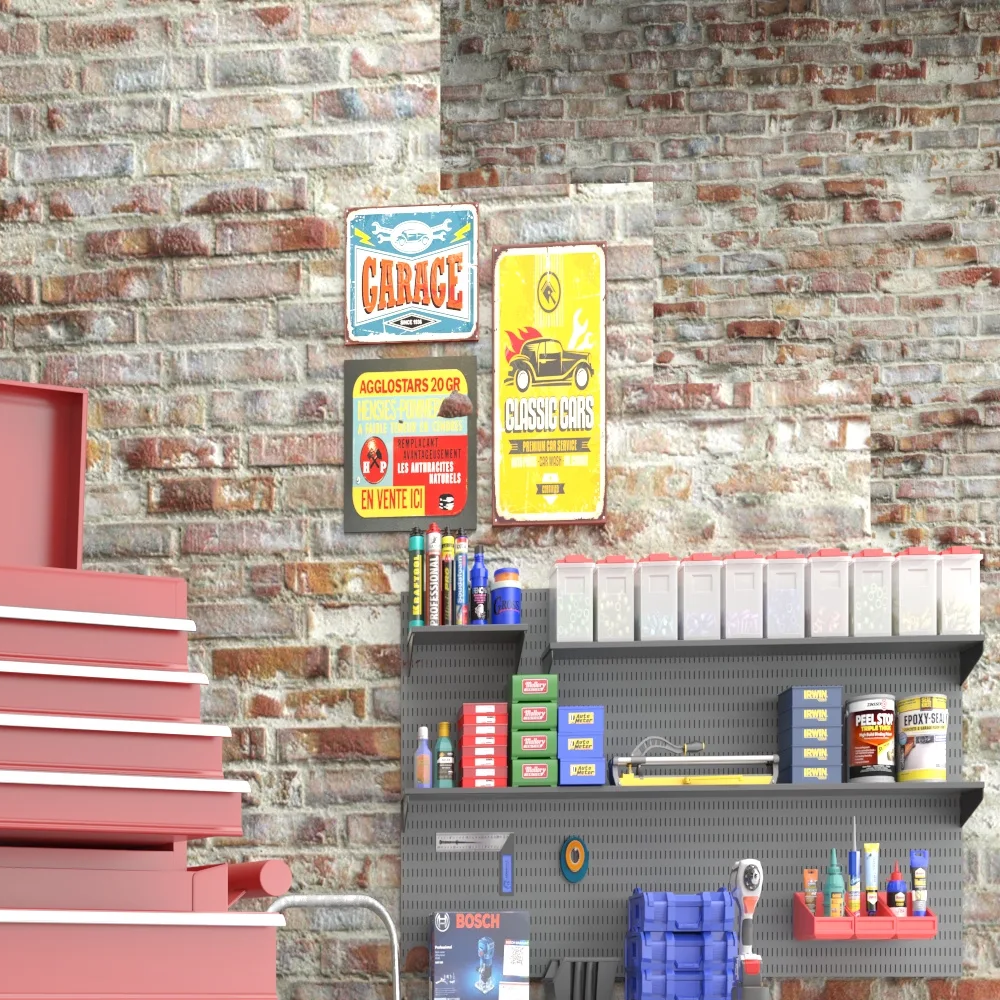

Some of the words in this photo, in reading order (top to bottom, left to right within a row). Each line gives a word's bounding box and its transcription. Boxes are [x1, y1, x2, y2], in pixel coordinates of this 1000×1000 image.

[361, 252, 463, 314] GARAGE
[359, 378, 429, 394] AGGLOSTARS
[430, 377, 444, 392] 20
[446, 377, 461, 392] GR
[504, 397, 557, 434] CLASSIC
[559, 395, 595, 432] CARS
[557, 439, 577, 451] SERVICE
[403, 448, 461, 460] AVANTAGEUSEMENT
[363, 461, 370, 474] H
[379, 461, 387, 474] P
[397, 462, 409, 474] LES
[361, 489, 374, 510] EN
[377, 488, 407, 509] VENTE
[410, 487, 422, 509] ICI
[412, 555, 421, 615] KRAFTOOL
[429, 555, 440, 626] PROFESSIONAL
[803, 689, 828, 700] IRWIN
[803, 709, 828, 720] IRWIN
[855, 714, 876, 726] PEEL
[803, 728, 828, 739] IRWIN
[803, 748, 828, 759] IRWIN
[803, 767, 828, 778] IRWIN
[455, 913, 500, 928] BOSCH
